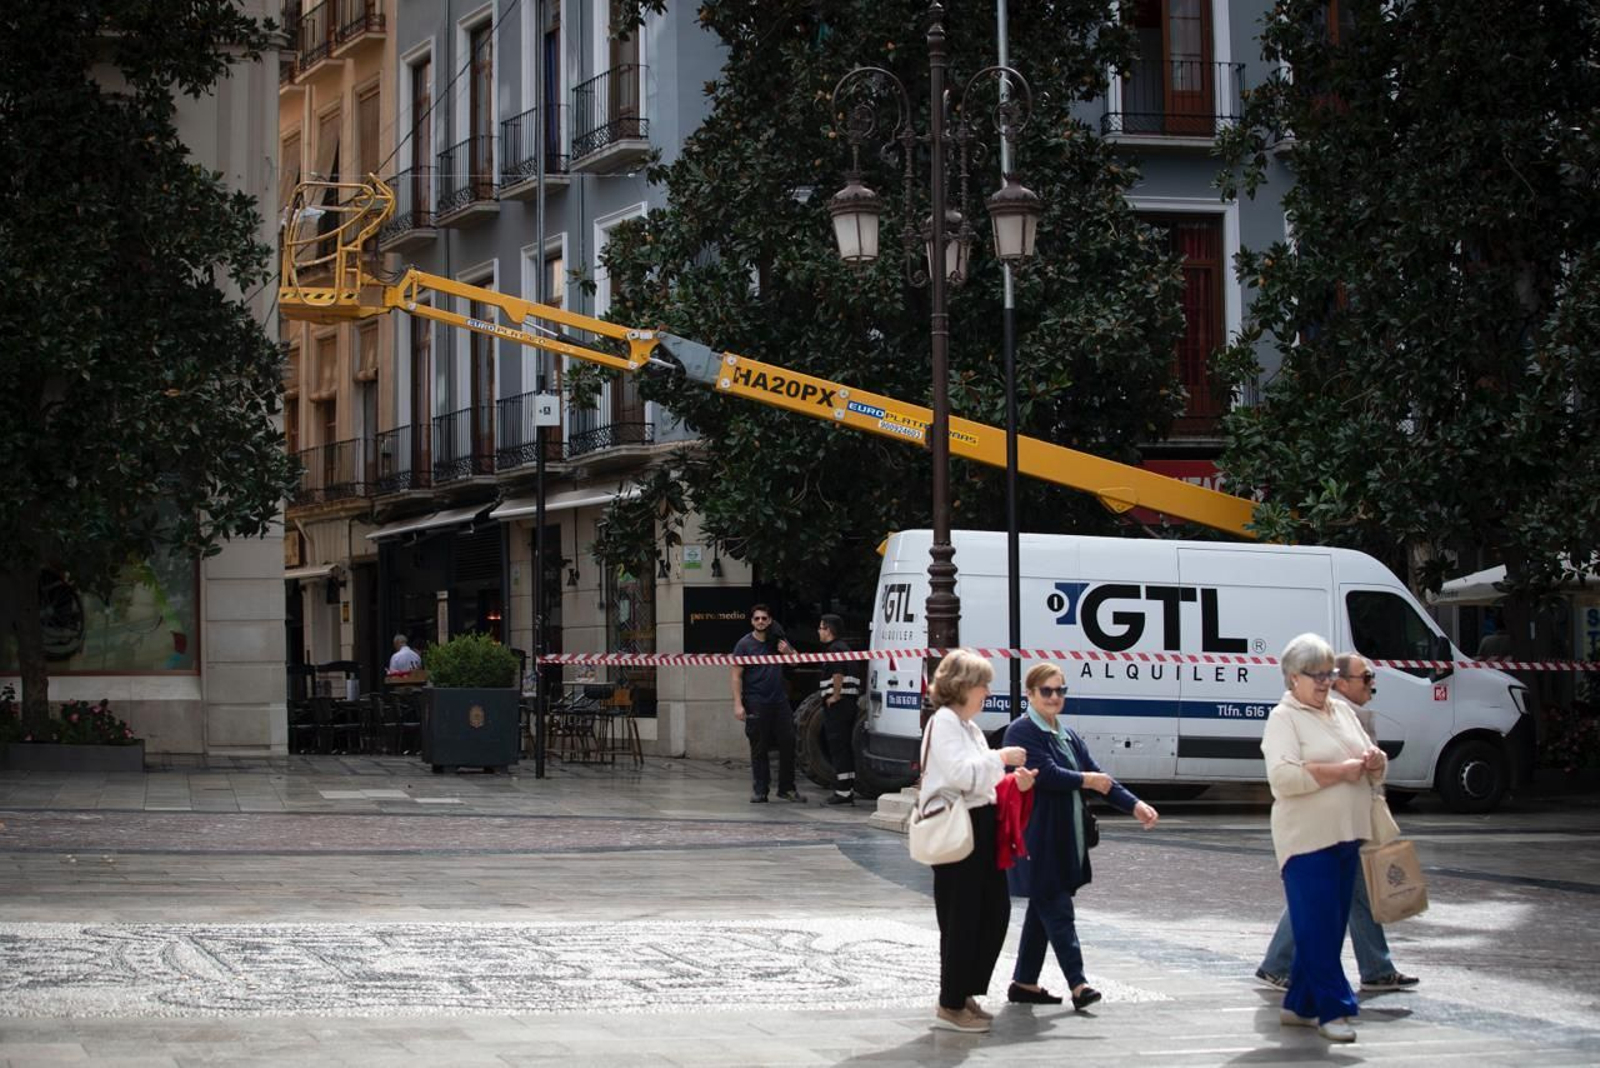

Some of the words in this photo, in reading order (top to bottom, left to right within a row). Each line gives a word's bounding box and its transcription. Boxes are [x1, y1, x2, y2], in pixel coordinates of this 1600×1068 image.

[733, 366, 837, 408] HA20PX
[884, 583, 915, 624] GTL
[1080, 583, 1248, 653] GTL
[1080, 662, 1249, 683] ALQUILER
[1216, 704, 1243, 718] Tlfn.
[1245, 705, 1265, 719] 616
